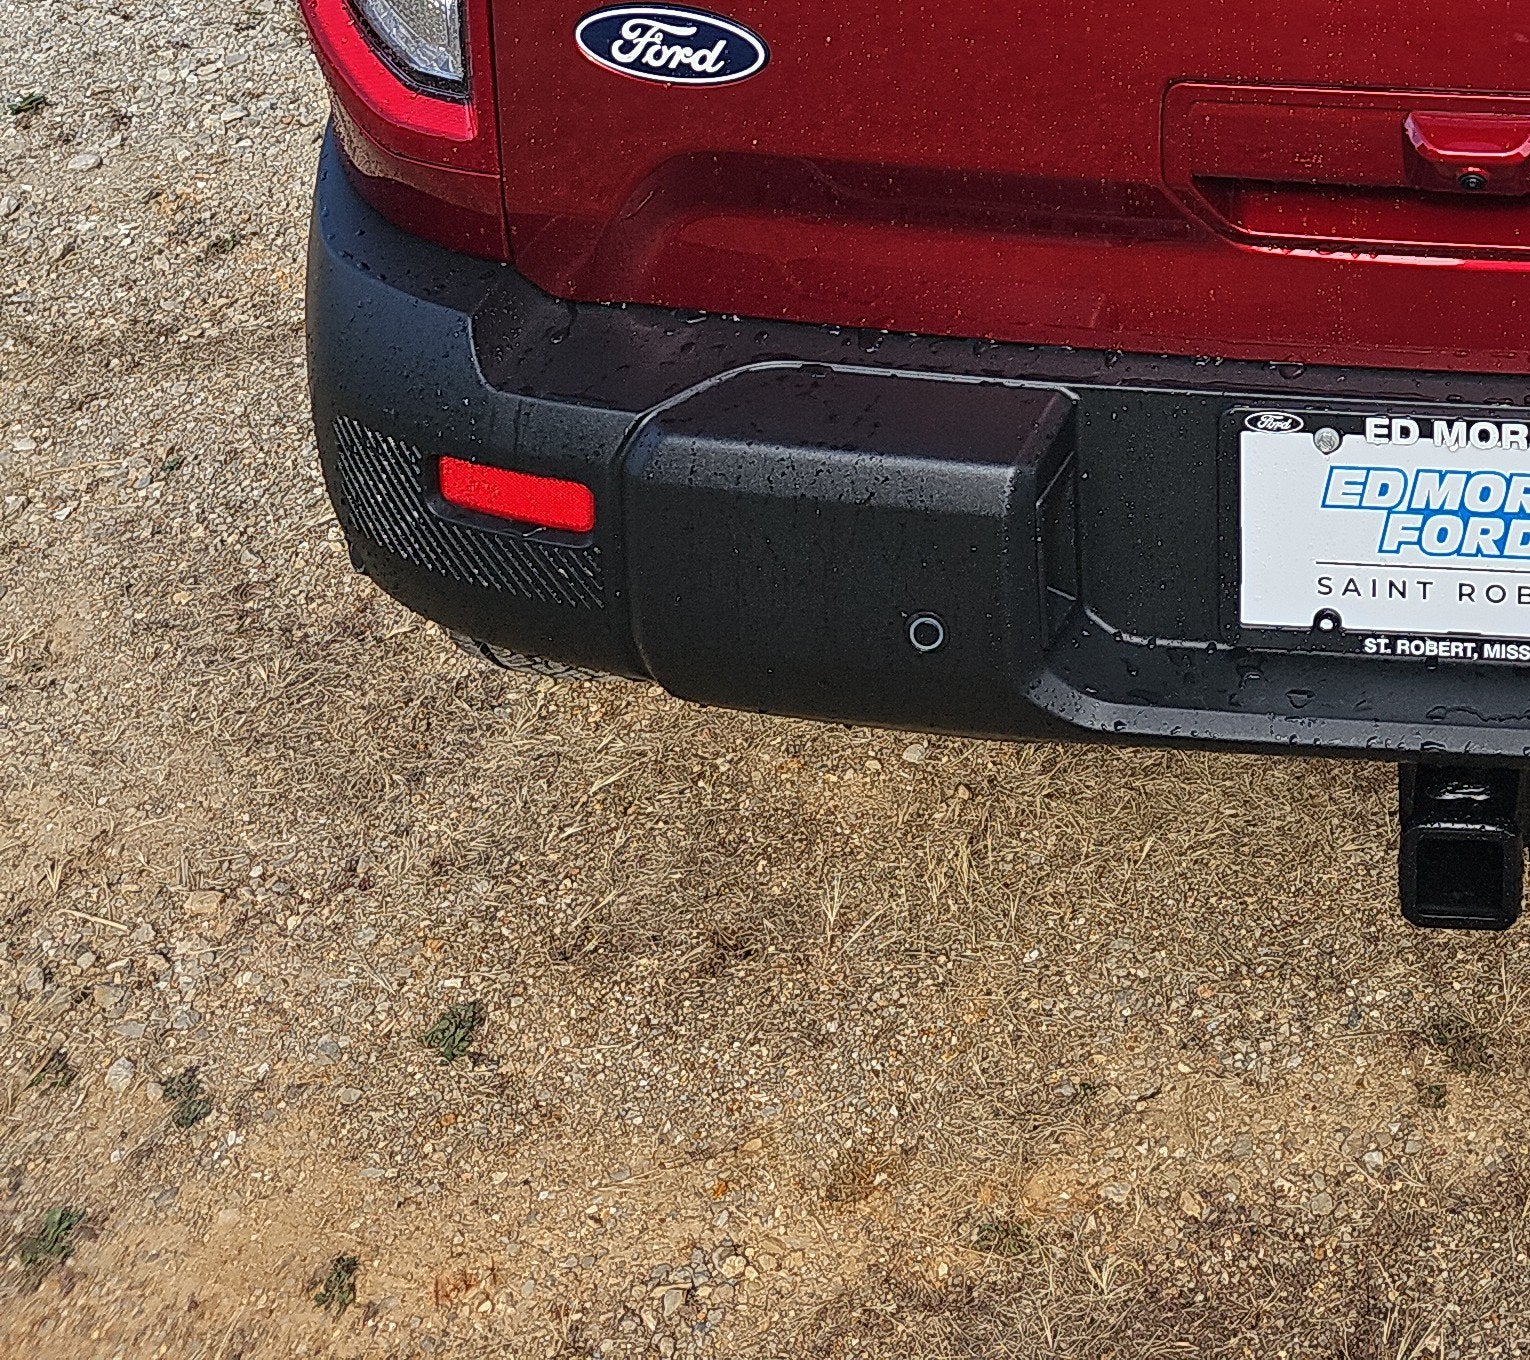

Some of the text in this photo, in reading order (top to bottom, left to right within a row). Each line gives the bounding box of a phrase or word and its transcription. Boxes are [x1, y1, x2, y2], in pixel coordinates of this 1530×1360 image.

[611, 18, 727, 73] Ford
[1257, 414, 1293, 430] Ford
[1364, 417, 1419, 446] ED
[1321, 466, 1408, 511] ED
[1316, 577, 1433, 601] SAINT
[1364, 637, 1391, 655] ST.
[1397, 639, 1479, 660] ROBERT,
